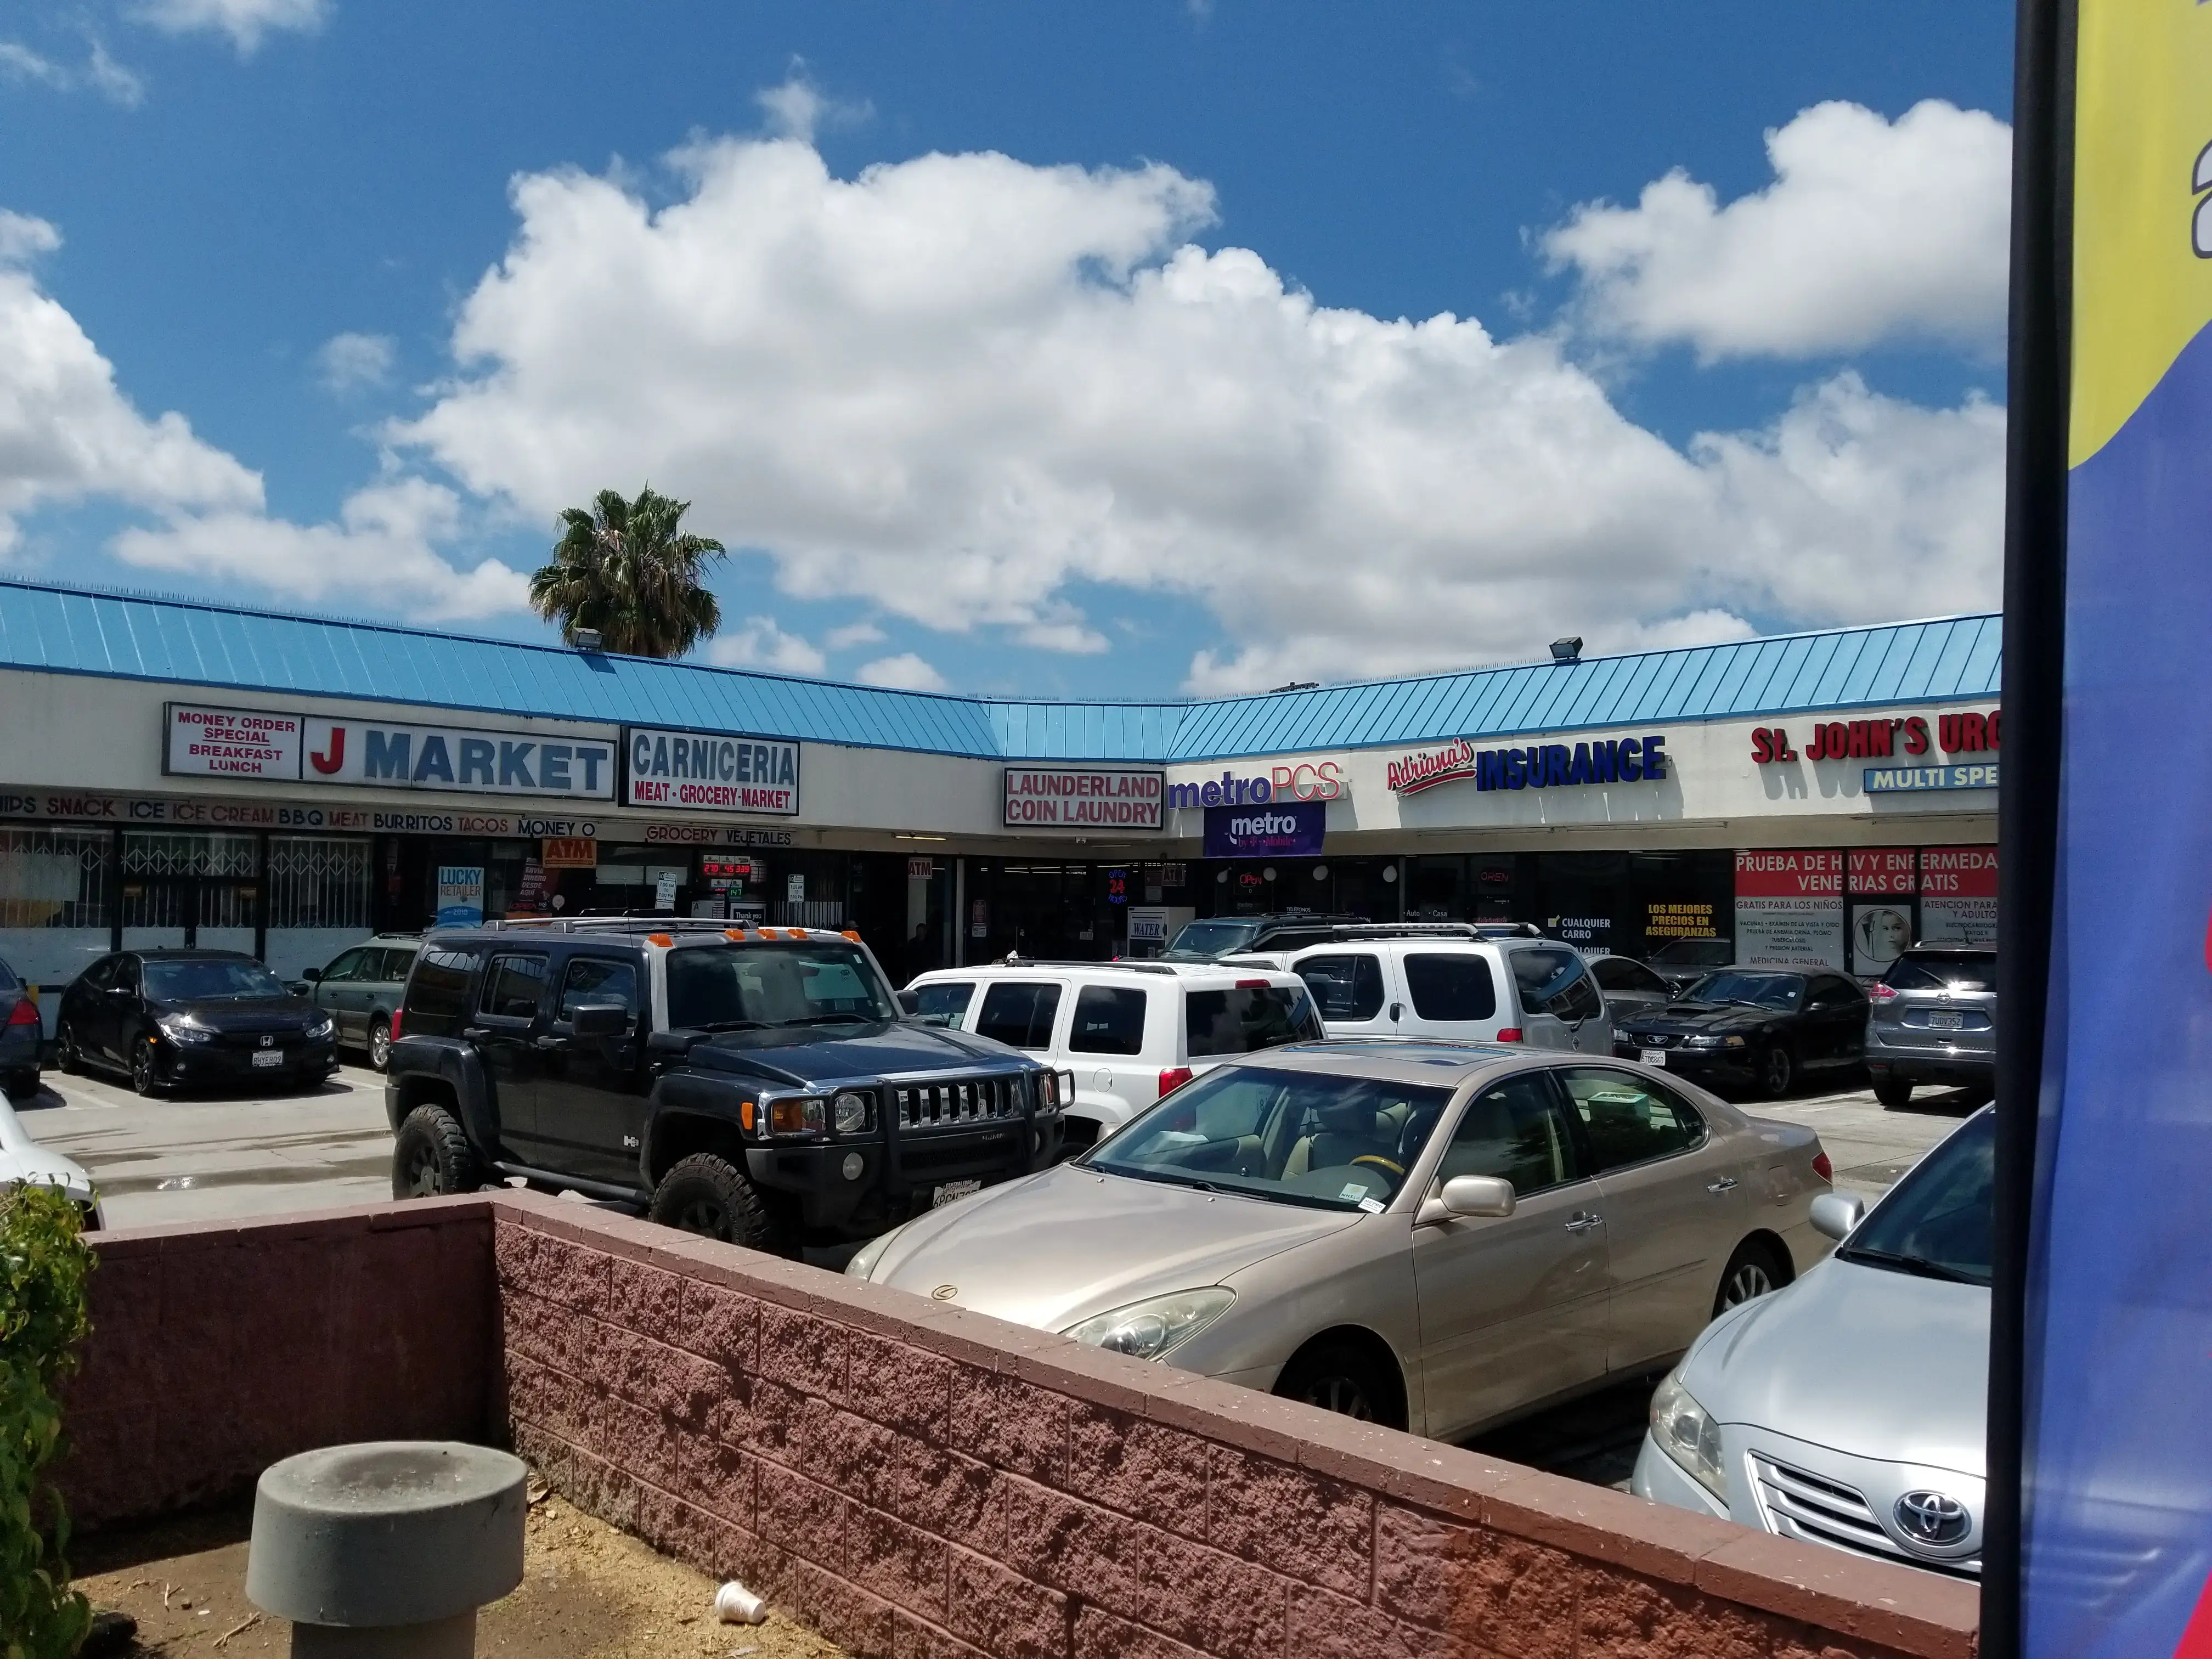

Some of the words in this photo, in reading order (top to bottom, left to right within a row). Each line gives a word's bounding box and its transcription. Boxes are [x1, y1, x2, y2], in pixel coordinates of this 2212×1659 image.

[178, 712, 235, 727] MONEY
[240, 716, 296, 732] ORDER
[204, 728, 270, 743] SPECIAL
[1751, 727, 1798, 763] St.
[1806, 716, 1929, 760] JOHN'S
[189, 743, 283, 761] BREAKFAST
[311, 727, 346, 775] J
[364, 730, 608, 791] MARKET
[633, 734, 795, 785] CARNICERIA
[209, 759, 262, 773] LUNCH
[1387, 737, 1472, 791] Adriana's
[1476, 735, 1667, 792] INSURANCE
[1169, 761, 1341, 809] metroPCS
[1874, 768, 1945, 789] MULTI
[1954, 766, 1998, 786] SPE
[634, 780, 670, 802] MEAT
[1007, 774, 1160, 798] LAUNDERLAND
[47, 797, 116, 817] SNACK
[129, 800, 164, 819] ICE
[173, 803, 206, 821] ICE
[211, 804, 274, 823] CREAM
[279, 809, 323, 825] BBQ
[329, 811, 368, 828] MEAT
[374, 814, 453, 832] BURRITOS
[458, 816, 508, 832] TACOS
[518, 820, 575, 836] MONEY
[582, 823, 595, 836] O
[1007, 799, 1057, 821] COIN
[1064, 800, 1160, 823] LAUNDRY
[1231, 812, 1296, 835] metro
[646, 826, 718, 844] GROCERY
[726, 830, 791, 845] VEJETALES
[1238, 837, 1247, 849] by
[547, 840, 593, 859] ATM
[909, 862, 931, 876] ATM
[1736, 854, 1798, 872] PRUEBA
[1804, 854, 1825, 871] DE
[1831, 854, 1865, 871] HIV
[1870, 854, 1881, 871] Y
[441, 868, 481, 885] LUCKY
[1109, 869, 1126, 878] OPEN
[1239, 874, 1262, 885] OPEN
[1481, 872, 1508, 882] OPEN
[1110, 879, 1125, 893] 24
[1893, 873, 1959, 891] GRATIS
[441, 885, 481, 896] RETAILER
[1649, 904, 1666, 913] LOS
[1668, 904, 1713, 915] MEJORES
[1736, 900, 1766, 909] GRATIS
[1768, 901, 1792, 910] PARA
[1795, 901, 1810, 910] LOS
[1814, 899, 1843, 910] NIÑOS
[1652, 916, 1695, 926] PRECIOS
[1696, 916, 1709, 926] EN
[1961, 910, 1996, 918] ADULTO
[1133, 923, 1160, 936] WATER
[1562, 918, 1611, 928] CUALQUIER
[1562, 929, 1592, 939] CARRO
[1645, 927, 1717, 937] ASEGURANZAS
[1750, 956, 1789, 964] MEDICINA
[1792, 958, 1829, 967] GENERAL
[1931, 1017, 1961, 1025] 7UDV352
